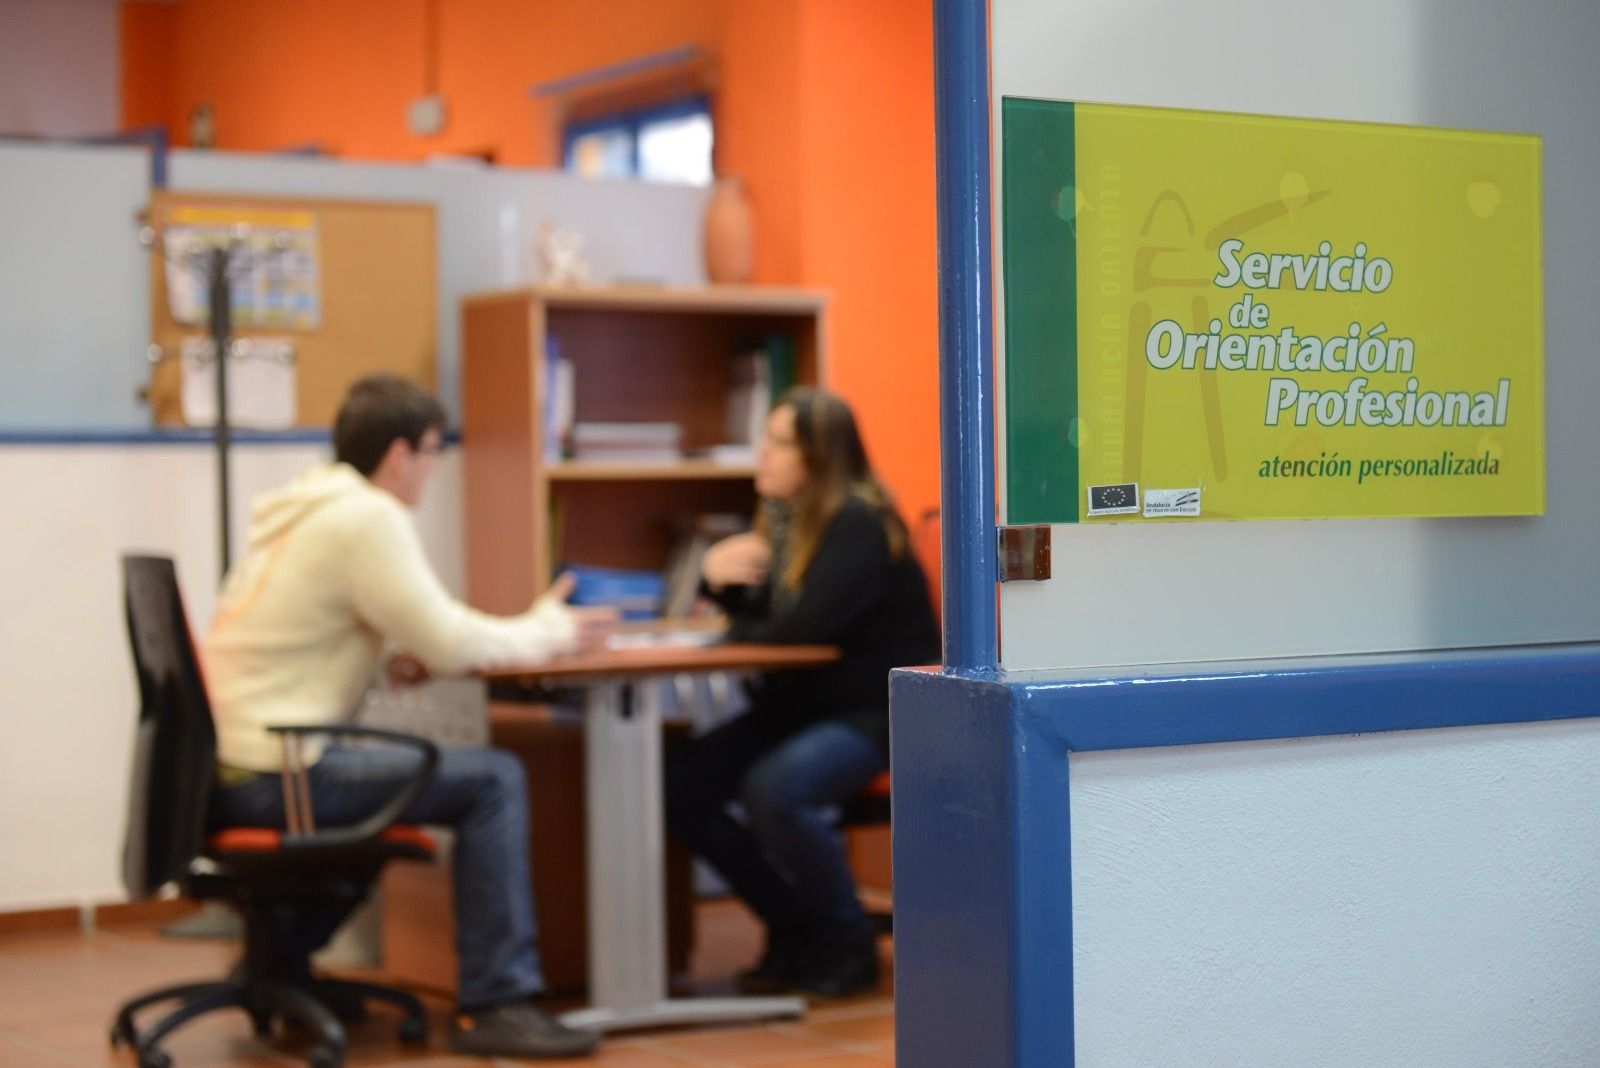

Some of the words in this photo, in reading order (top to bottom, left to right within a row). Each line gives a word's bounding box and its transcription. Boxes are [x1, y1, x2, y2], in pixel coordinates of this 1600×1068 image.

[1213, 238, 1393, 293] Servicio
[1228, 293, 1270, 329] de
[1145, 318, 1415, 373] Orientación
[1264, 376, 1511, 427] Profesional
[1258, 452, 1352, 478] atención
[1357, 450, 1500, 484] personalizada
